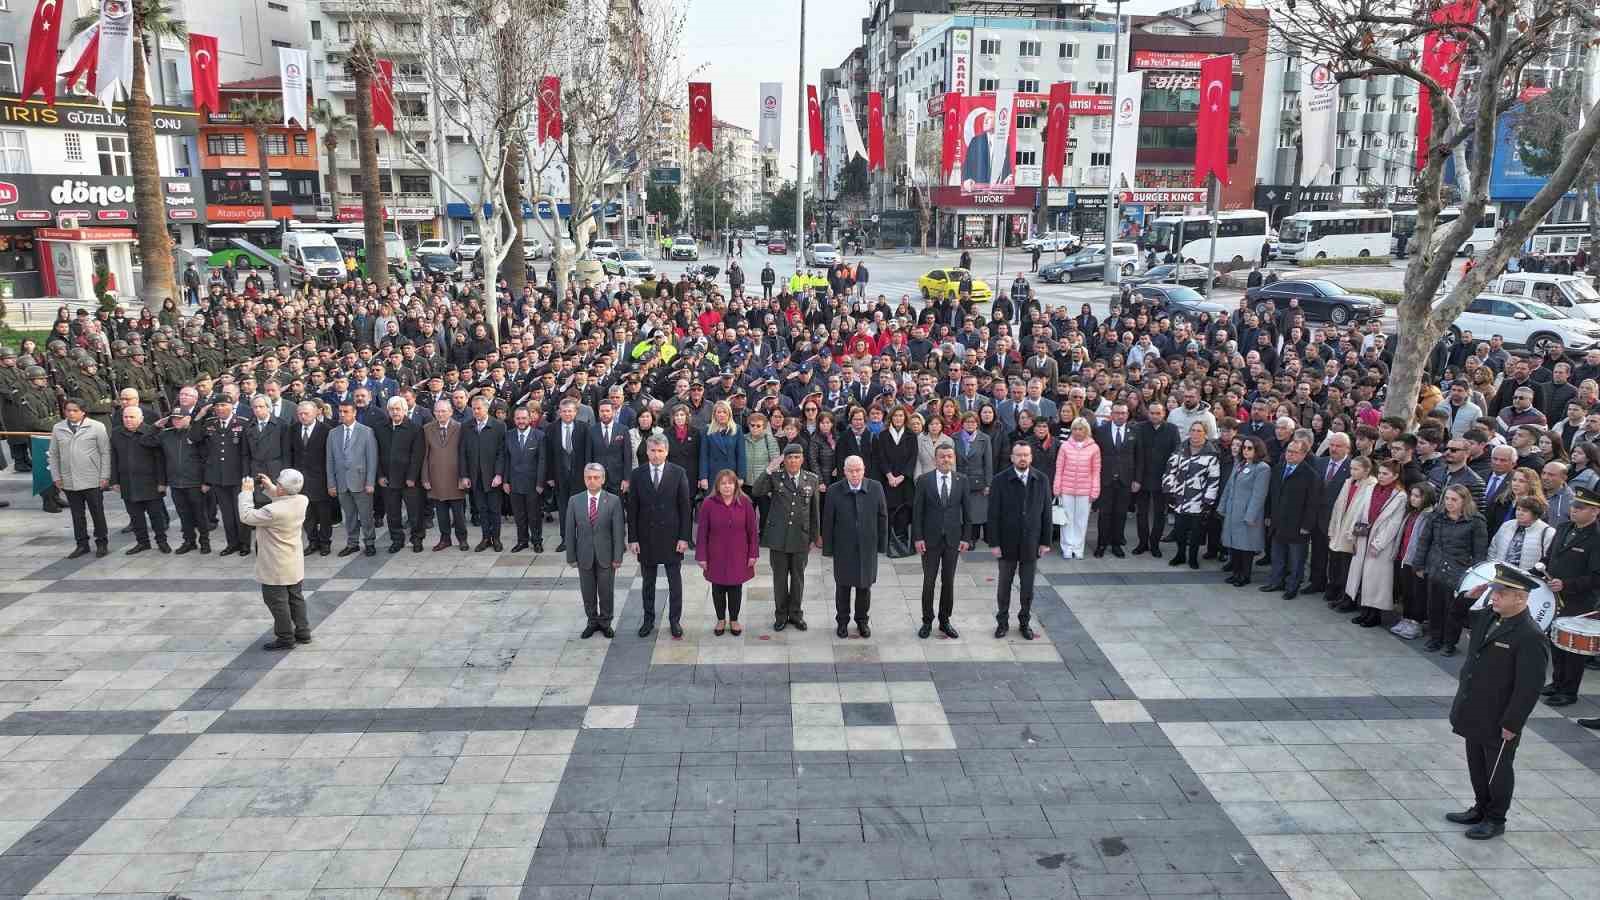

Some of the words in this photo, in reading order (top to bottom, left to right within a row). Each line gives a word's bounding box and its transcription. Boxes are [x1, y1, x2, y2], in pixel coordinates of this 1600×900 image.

[5, 105, 59, 123] IRIS
[1133, 193, 1169, 202] BURGER
[1171, 193, 1195, 202] KING
[246, 209, 265, 219] Opti
